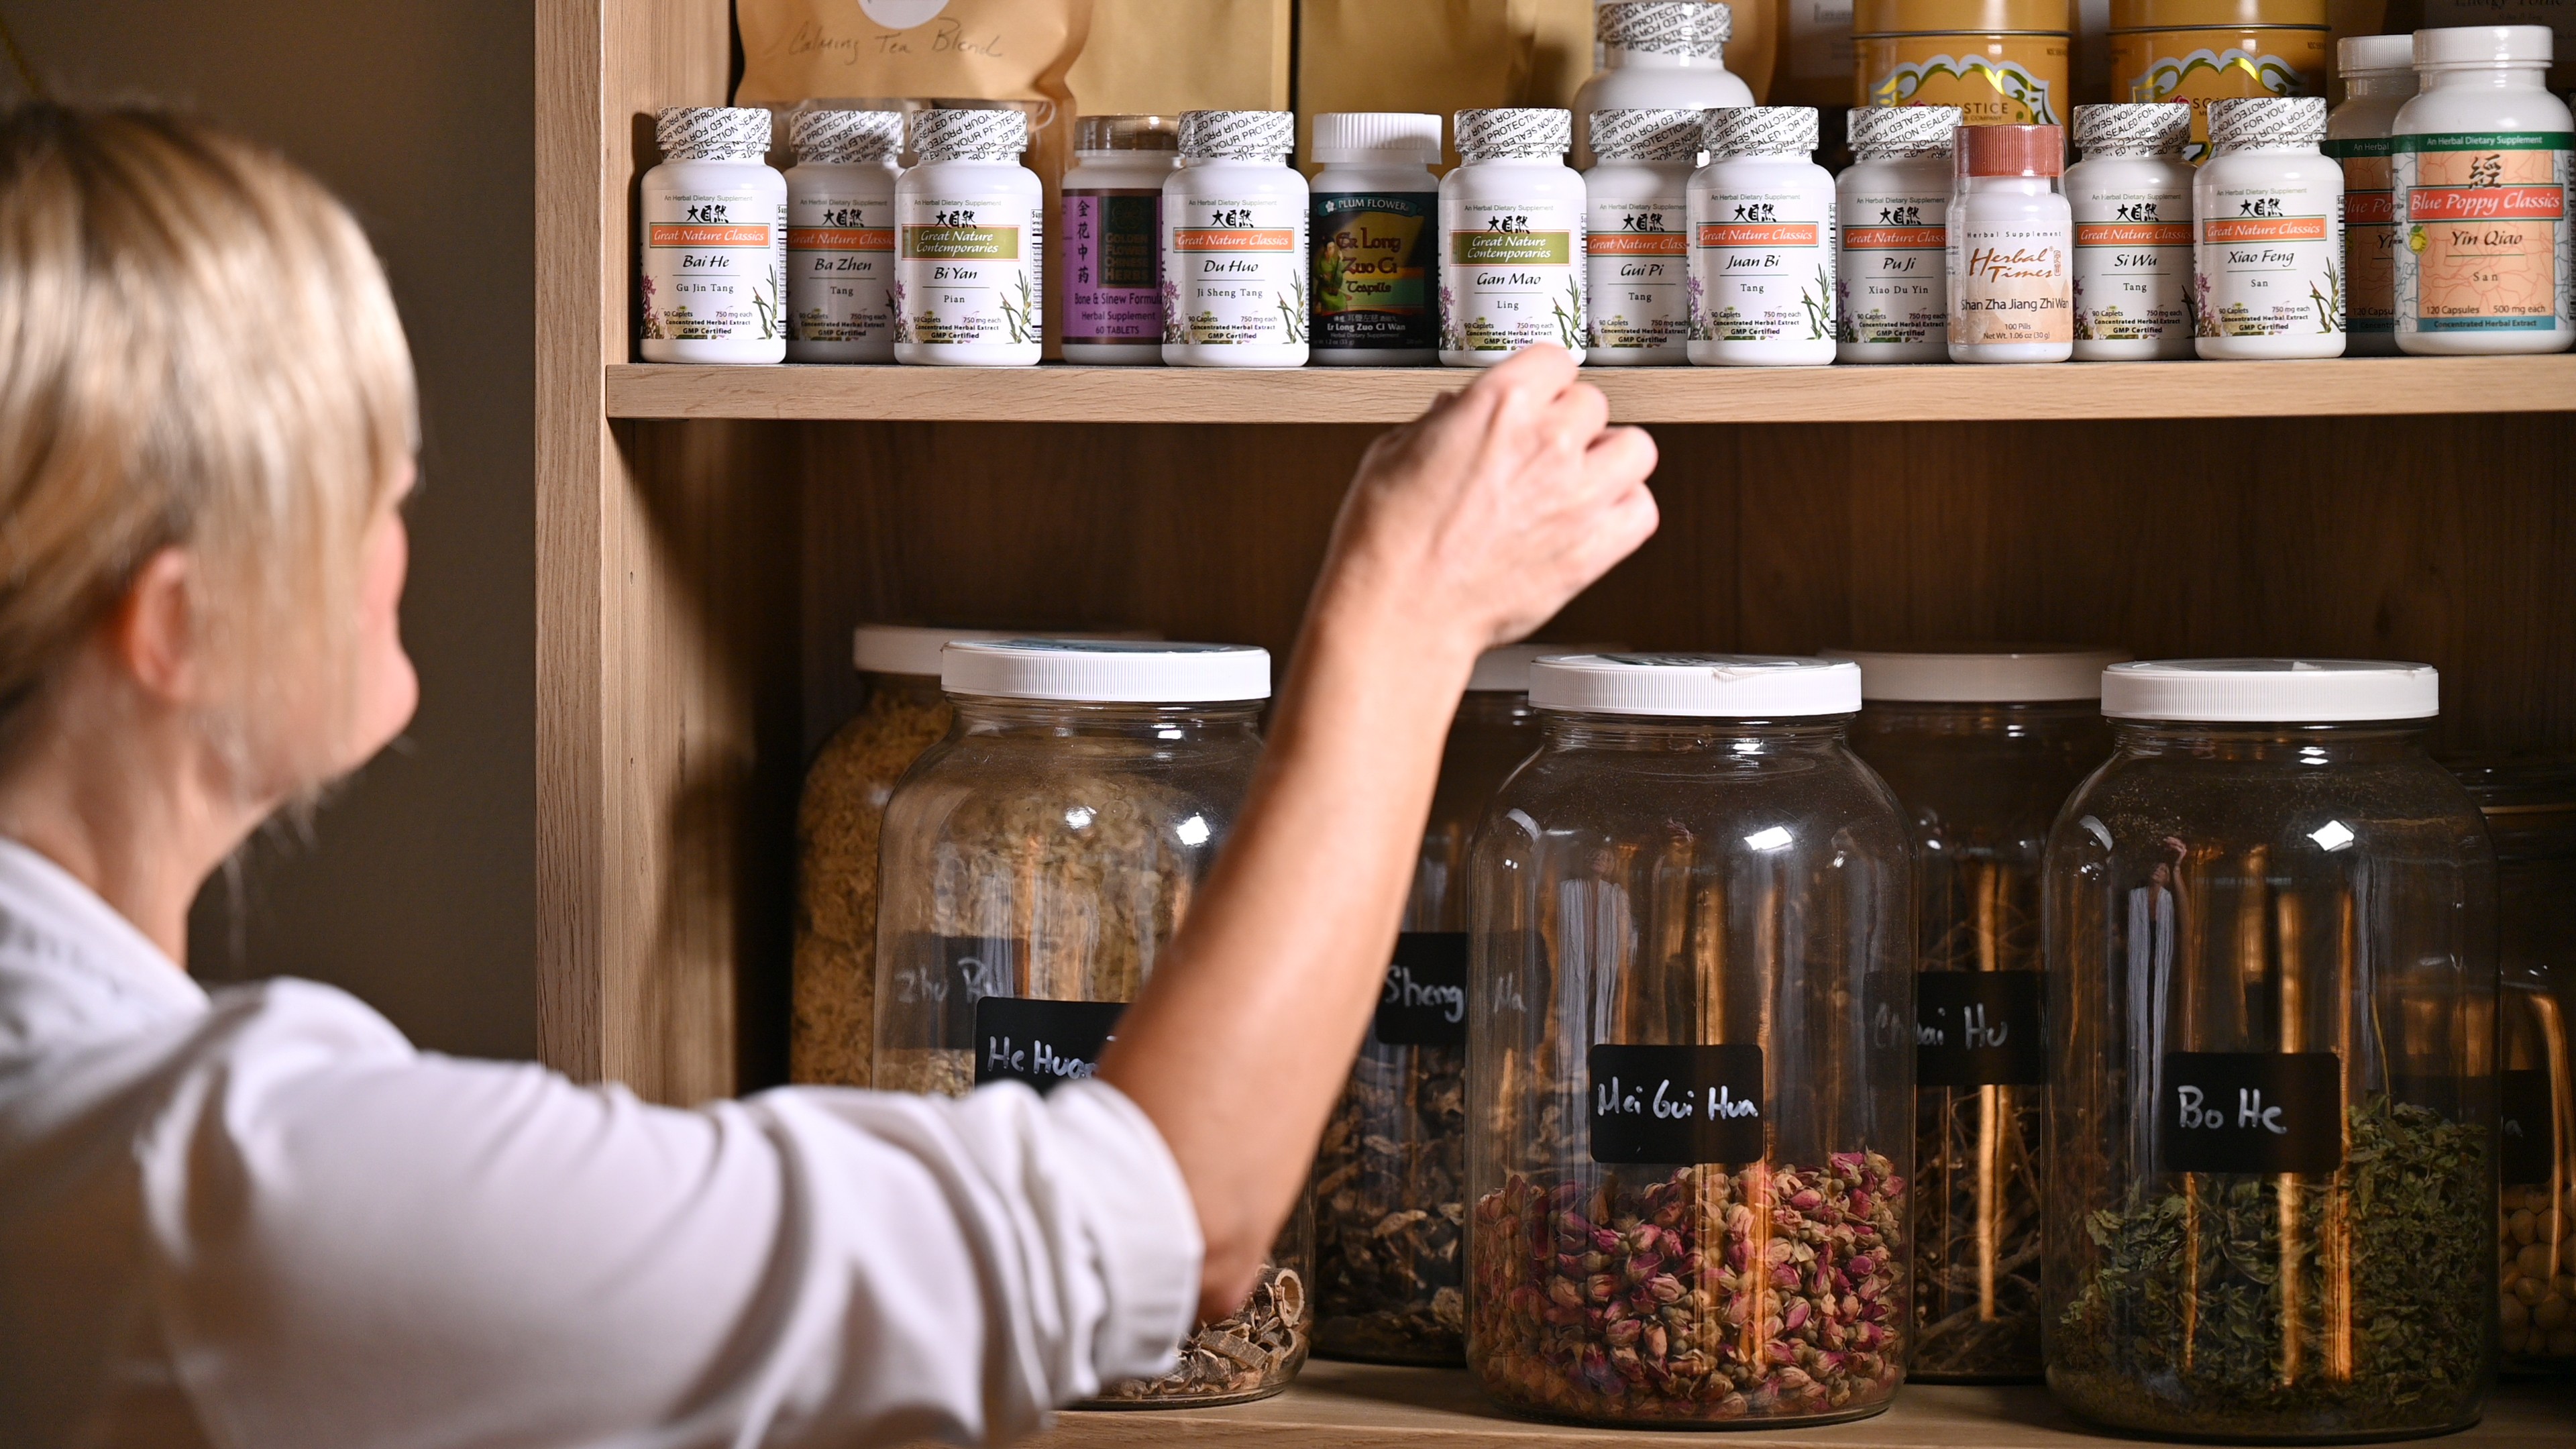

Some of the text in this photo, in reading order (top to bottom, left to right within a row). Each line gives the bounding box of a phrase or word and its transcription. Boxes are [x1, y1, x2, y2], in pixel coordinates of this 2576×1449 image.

[875, 32, 910, 54] Tea
[931, 17, 1003, 58] Blend
[2427, 136, 2542, 146] An Herbal Dietary Supplement
[1338, 199, 1405, 210] PLUM FLOWER
[2412, 190, 2560, 216] Blue Poppy Classics
[655, 230, 764, 241] Great Nature Classics
[1701, 227, 1813, 241] Great Nature Classics
[2081, 227, 2192, 240] Great Nature Classics
[2208, 222, 2320, 237] Great Nature Classics
[921, 231, 994, 241] Great Nature
[1178, 233, 1289, 246] Great Nature Classics
[1360, 227, 1401, 252] Long
[1472, 236, 1546, 247] Great Nature
[2451, 231, 2522, 246] Yin Qiao
[916, 242, 998, 257] Contemporaries
[1468, 248, 1551, 262] Contemporaries
[683, 255, 729, 268] Bai He
[814, 257, 871, 270] Ba Zhen
[1725, 255, 1780, 269] Juan Bi
[1969, 248, 2048, 276] Herbal
[2114, 254, 2157, 266] Si Wu
[2228, 250, 2294, 267] Xiao Feng
[1204, 260, 1258, 272] Du Huo
[1621, 264, 1664, 276] Gui Pi
[1883, 258, 1917, 272] Pu Ji
[934, 267, 977, 279] Bi Yan
[1477, 272, 1541, 285] Gan Mao
[1988, 266, 2053, 282] Times
[2473, 272, 2498, 282] San
[676, 284, 734, 293] Gu Jin Tang
[830, 286, 853, 297] Tang
[1197, 288, 1263, 298] Ji Sheng Tang
[1741, 284, 1764, 294] Tang
[1912, 286, 1929, 294] Yin
[2123, 282, 2147, 292] Tang
[1075, 293, 1091, 305] Bone
[1093, 293, 1098, 305] &
[1101, 293, 1126, 305] Sinew
[1629, 292, 1652, 302] Tang
[1497, 301, 1519, 310] Ling
[1962, 299, 2069, 312] Shan Zha Jiang Zhi Wan
[2426, 305, 2545, 315] 120 Capsules 500 mg each
[1081, 311, 1155, 322] Herbal Supplement
[1095, 326, 1139, 334] 60 TABLETS
[1336, 323, 1354, 332] Long
[1964, 1003, 2008, 1050] Hu
[987, 1036, 1025, 1072] He
[1597, 1076, 1758, 1120] Mei Gui Hua
[2178, 1085, 2287, 1134] Bo He
